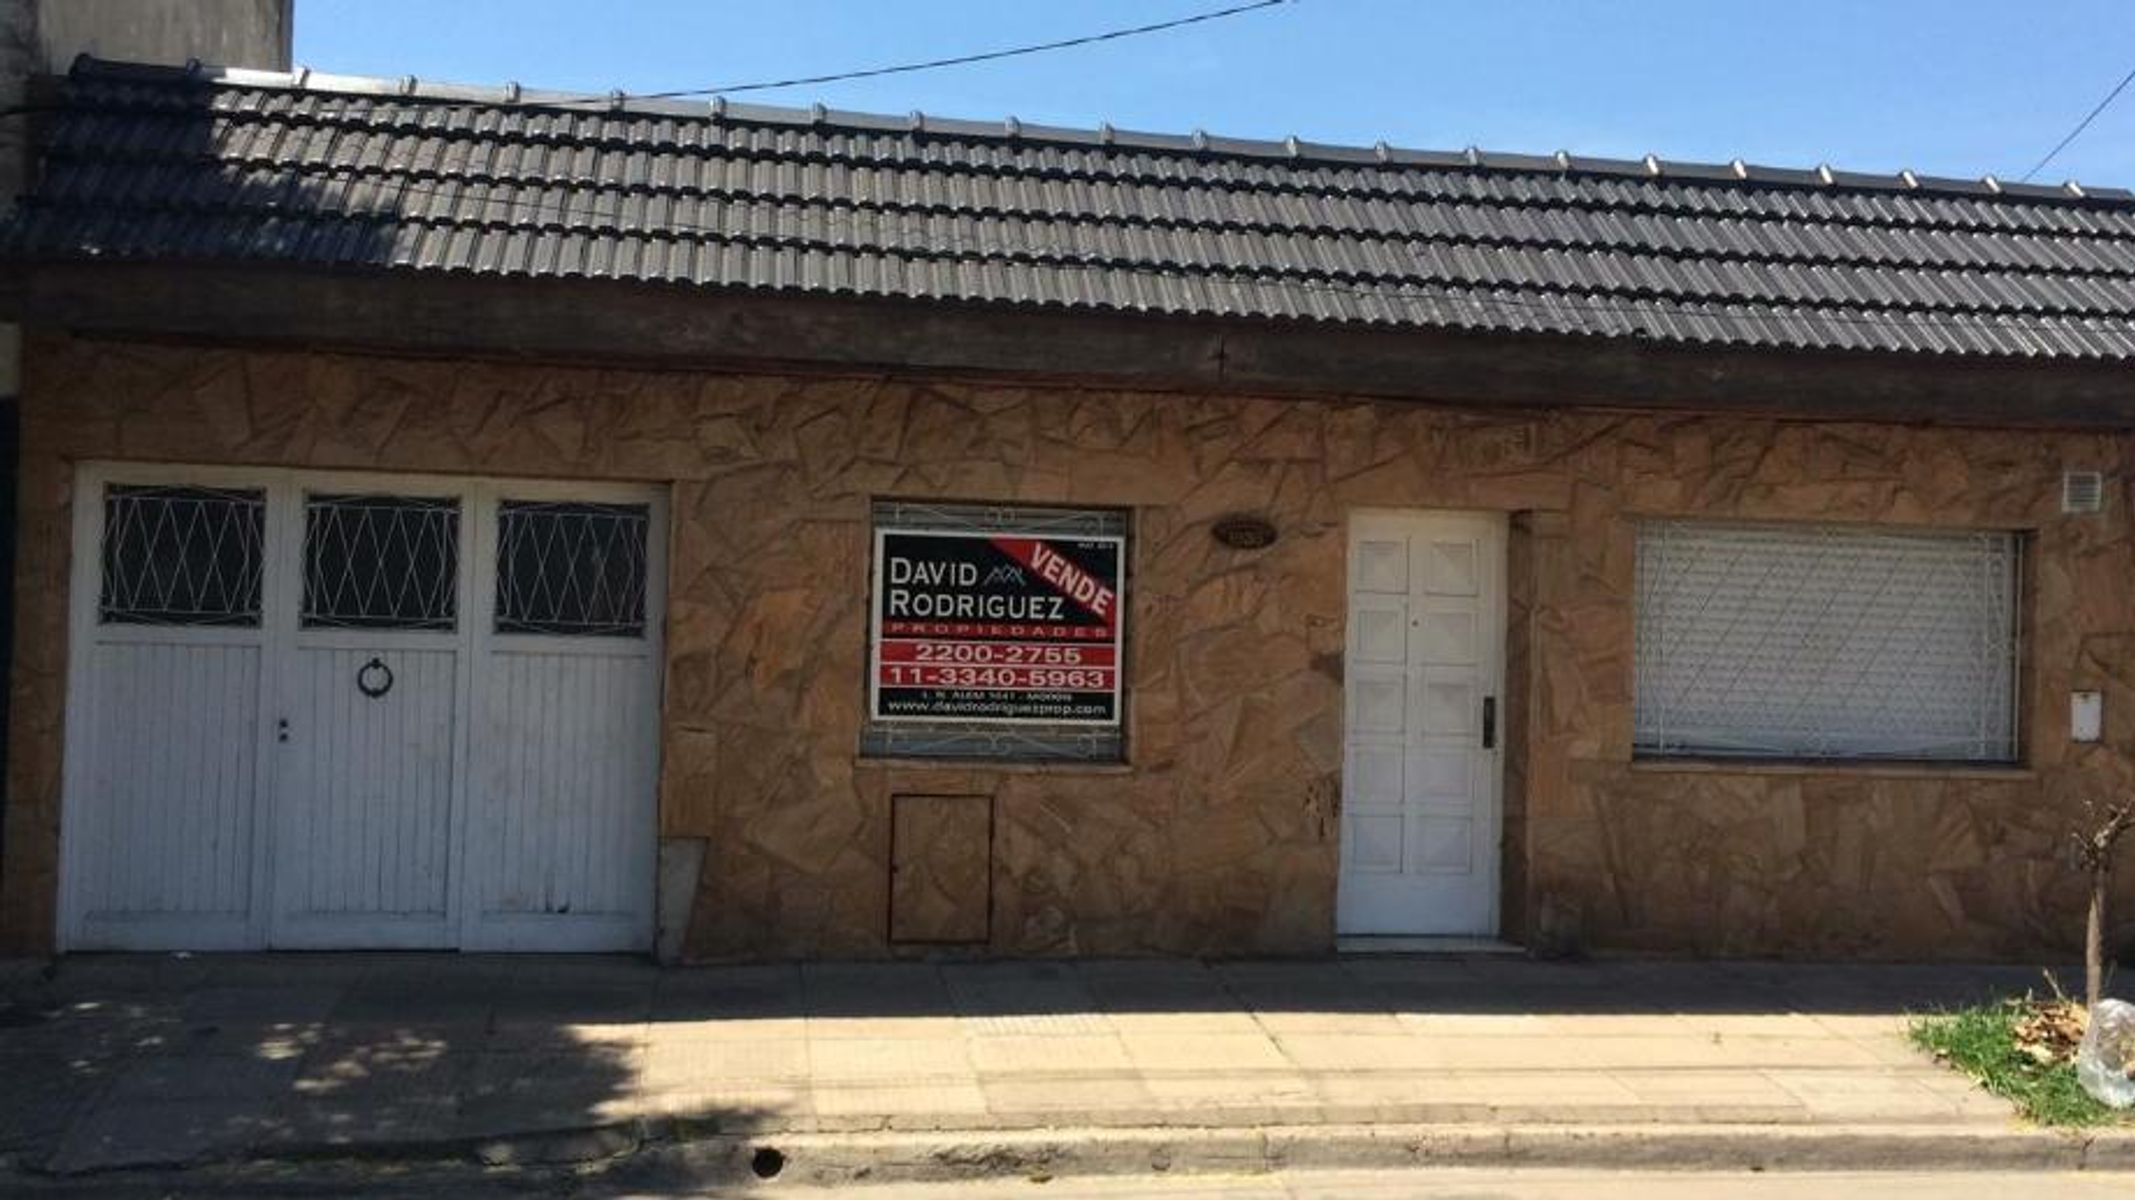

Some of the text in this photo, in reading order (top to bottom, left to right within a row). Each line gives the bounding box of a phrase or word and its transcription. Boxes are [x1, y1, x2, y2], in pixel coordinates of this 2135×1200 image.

[1030, 541, 1114, 616] VENDE
[890, 589, 1065, 620] RODRIGUEZ
[891, 623, 1108, 637] PROPIEDADES
[915, 644, 1082, 665] 2200-2755
[890, 666, 1105, 688] 11-3340-5963
[887, 701, 1107, 716] www.davidrodriguezprop.com
